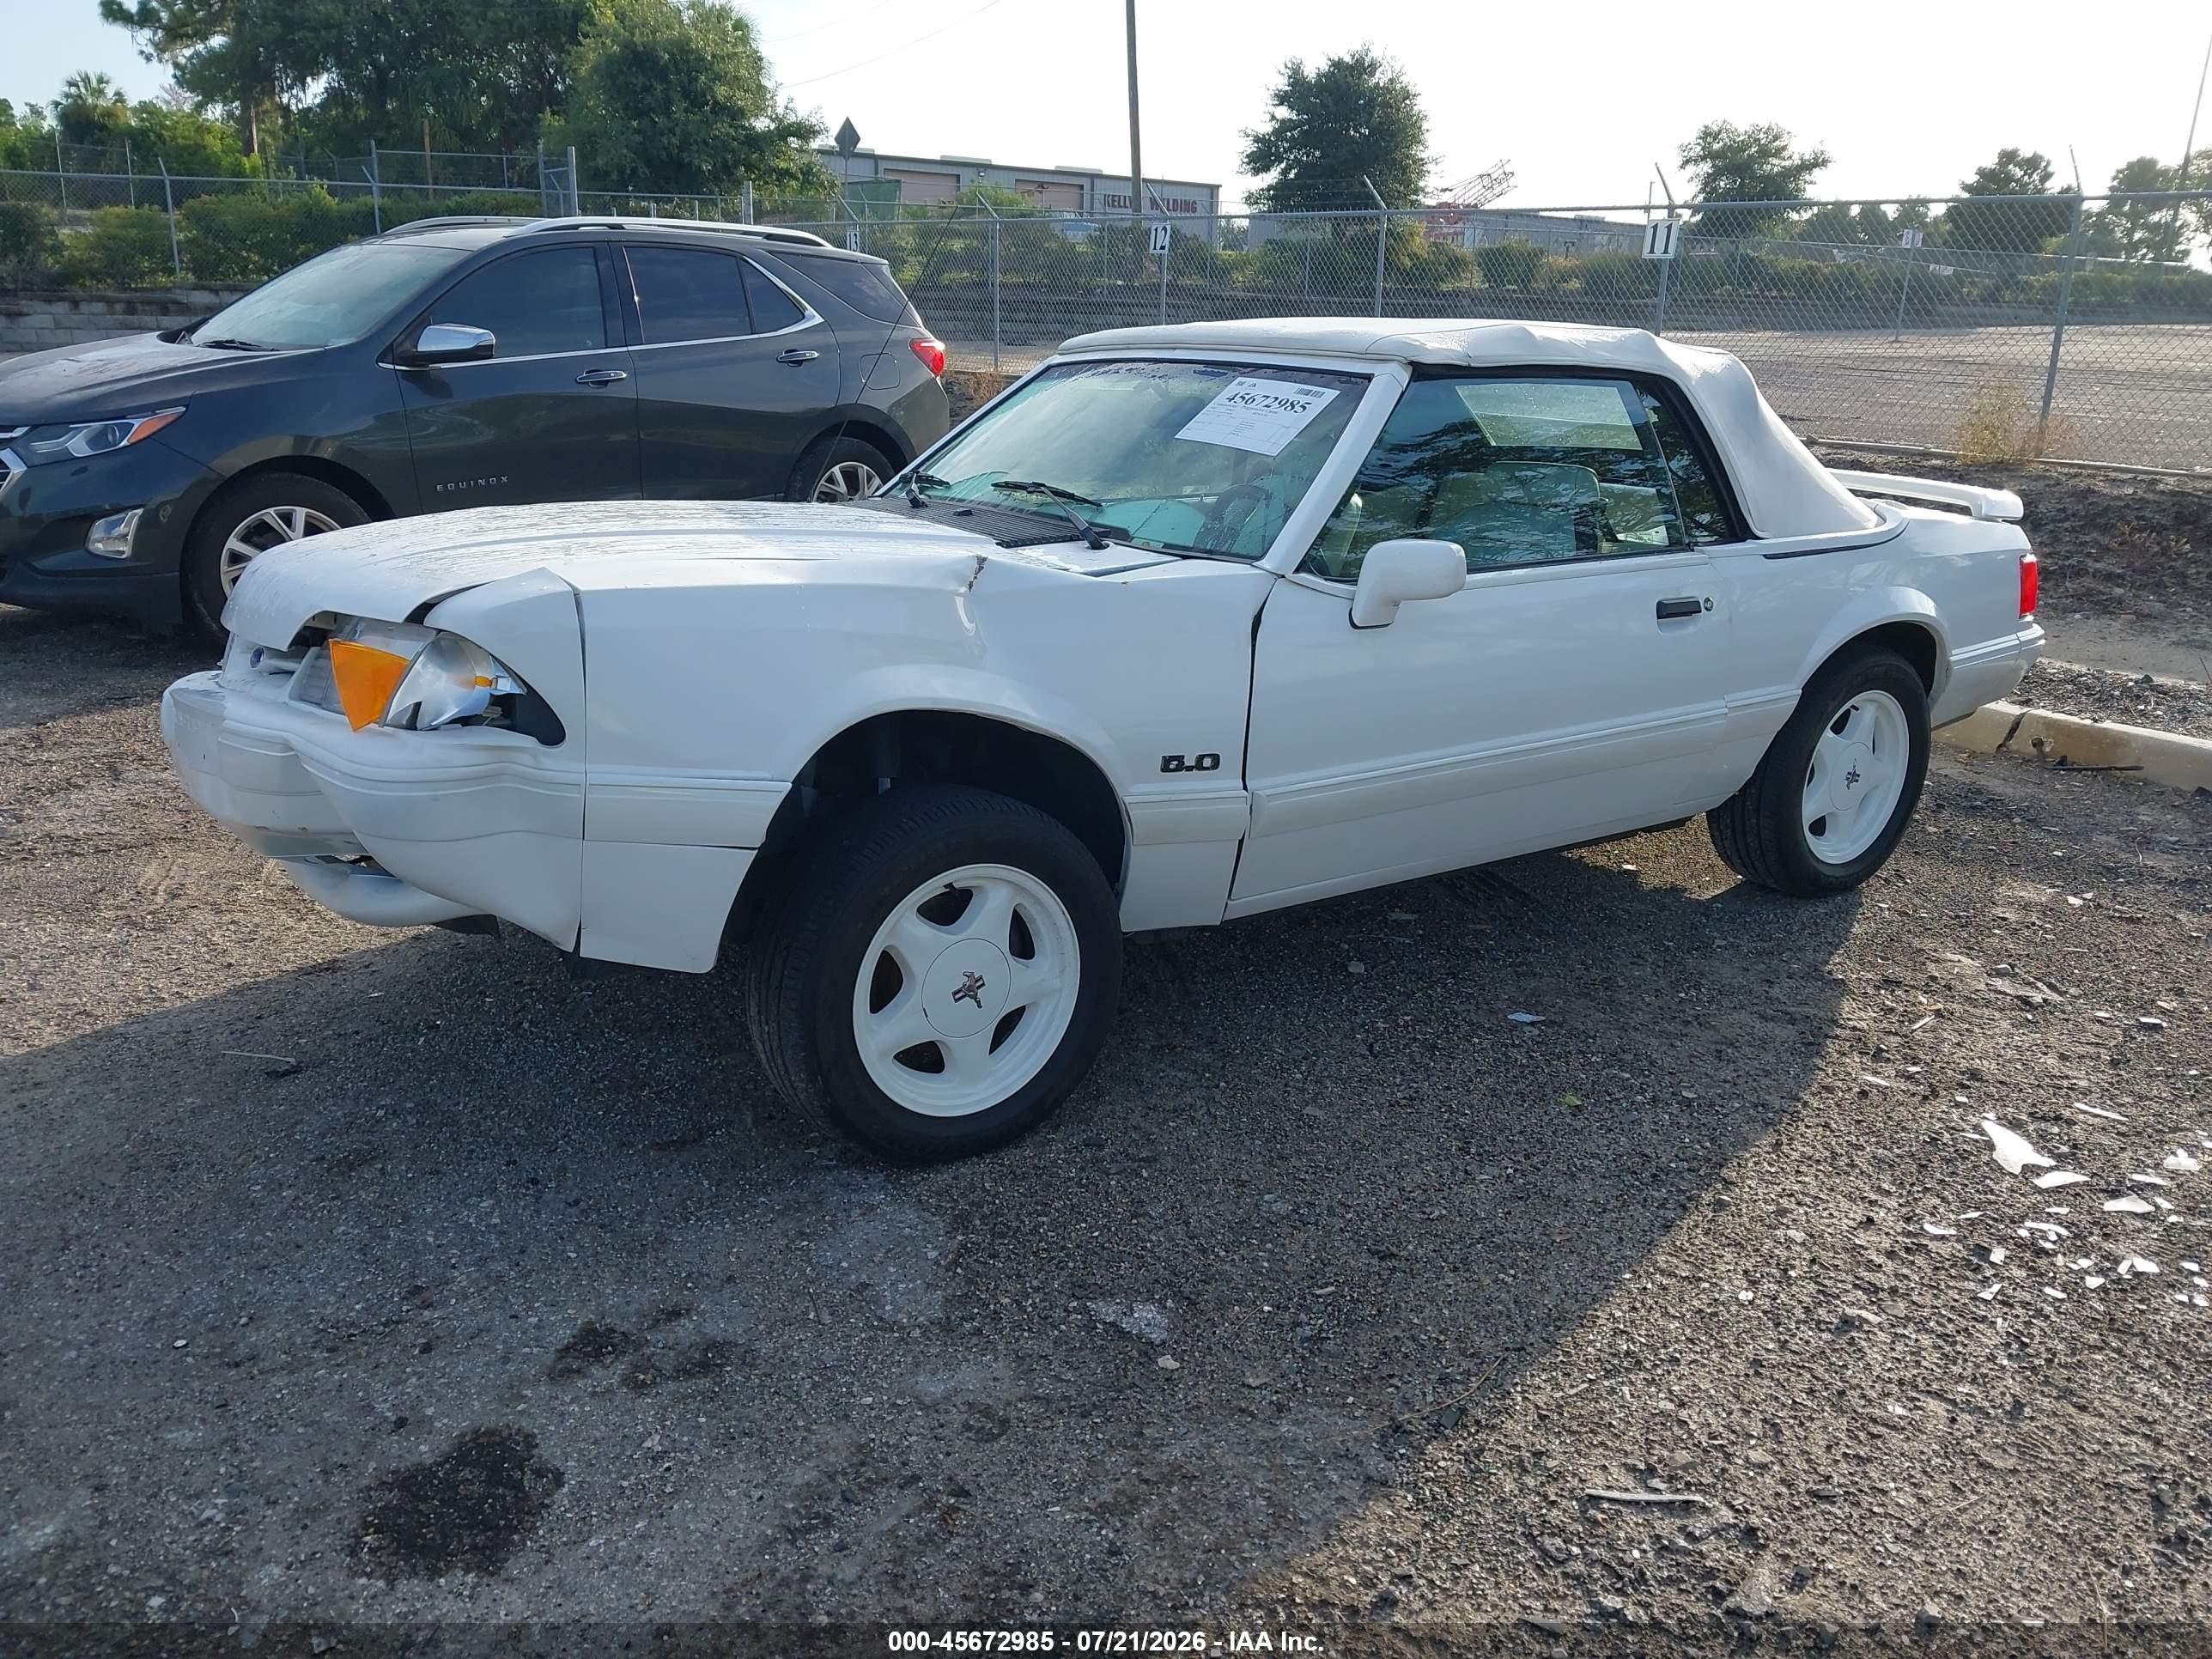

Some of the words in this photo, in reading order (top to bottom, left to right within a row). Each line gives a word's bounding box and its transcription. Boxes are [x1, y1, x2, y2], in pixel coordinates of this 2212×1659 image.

[848, 233, 858, 252] 13
[1153, 226, 1168, 251] 12
[1646, 222, 1673, 254] 11
[1225, 392, 1312, 414] 45672985
[436, 476, 508, 492] EQUINOX
